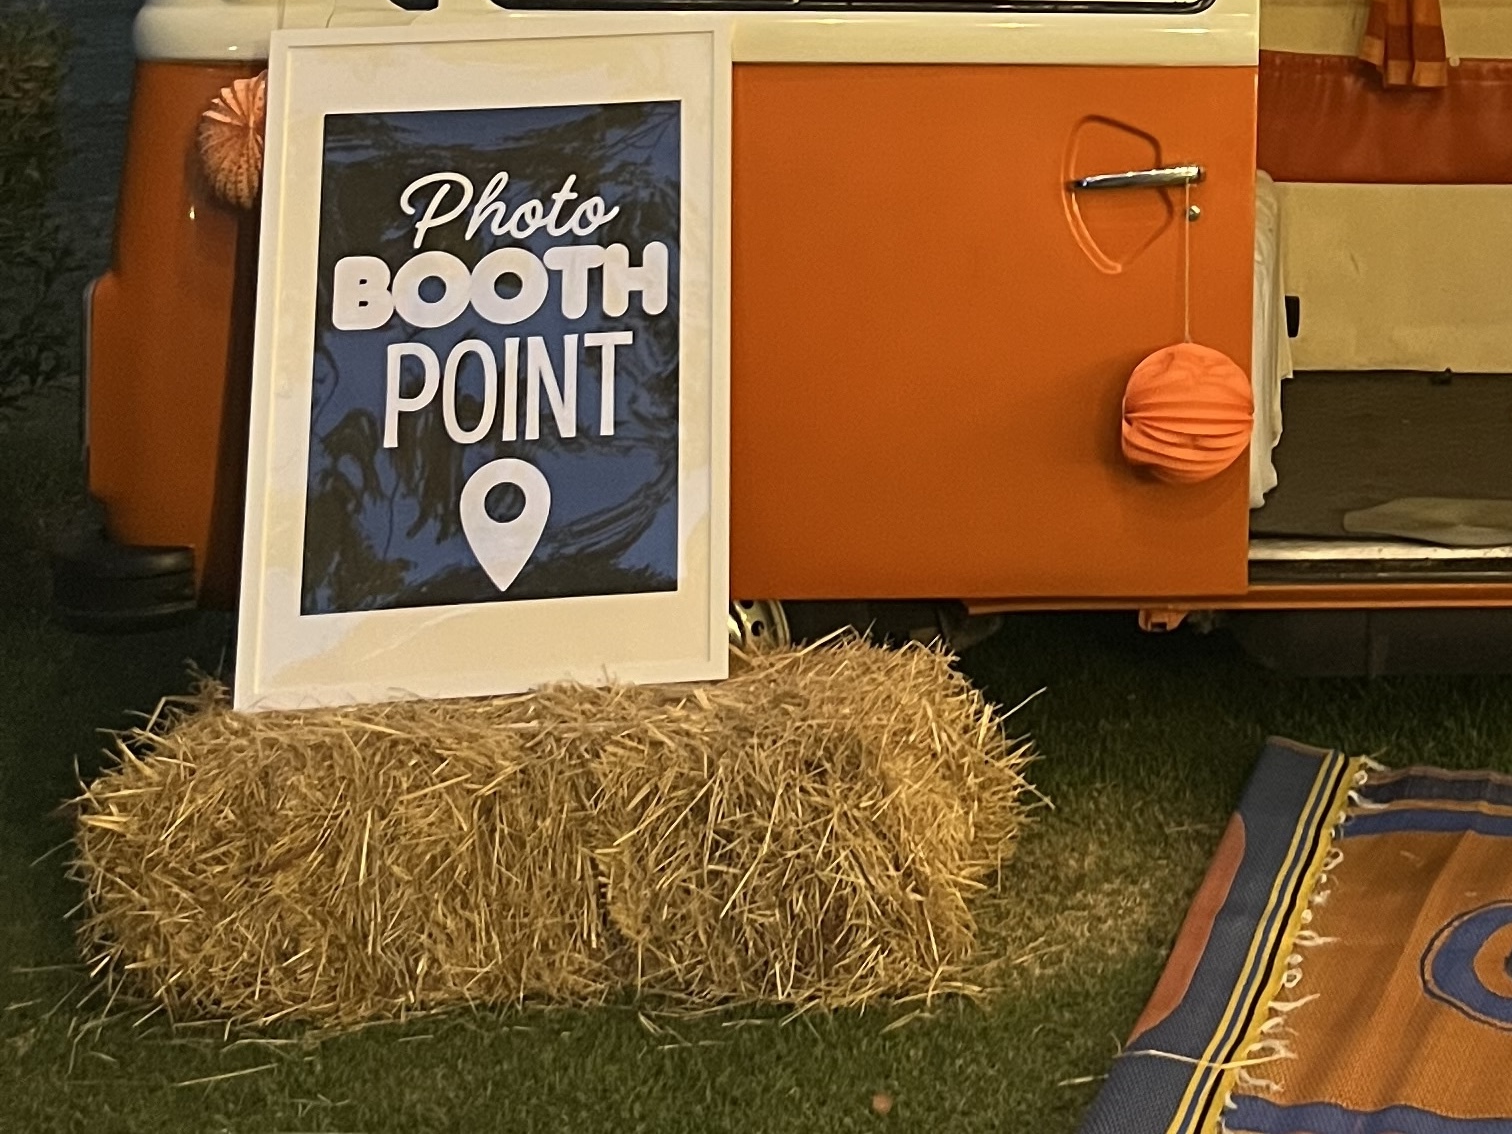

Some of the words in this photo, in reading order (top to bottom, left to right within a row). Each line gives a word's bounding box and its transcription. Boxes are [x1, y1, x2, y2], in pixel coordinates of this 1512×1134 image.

[399, 171, 619, 248] Photo
[331, 241, 669, 330] BOOTH
[383, 331, 633, 448] POINT
